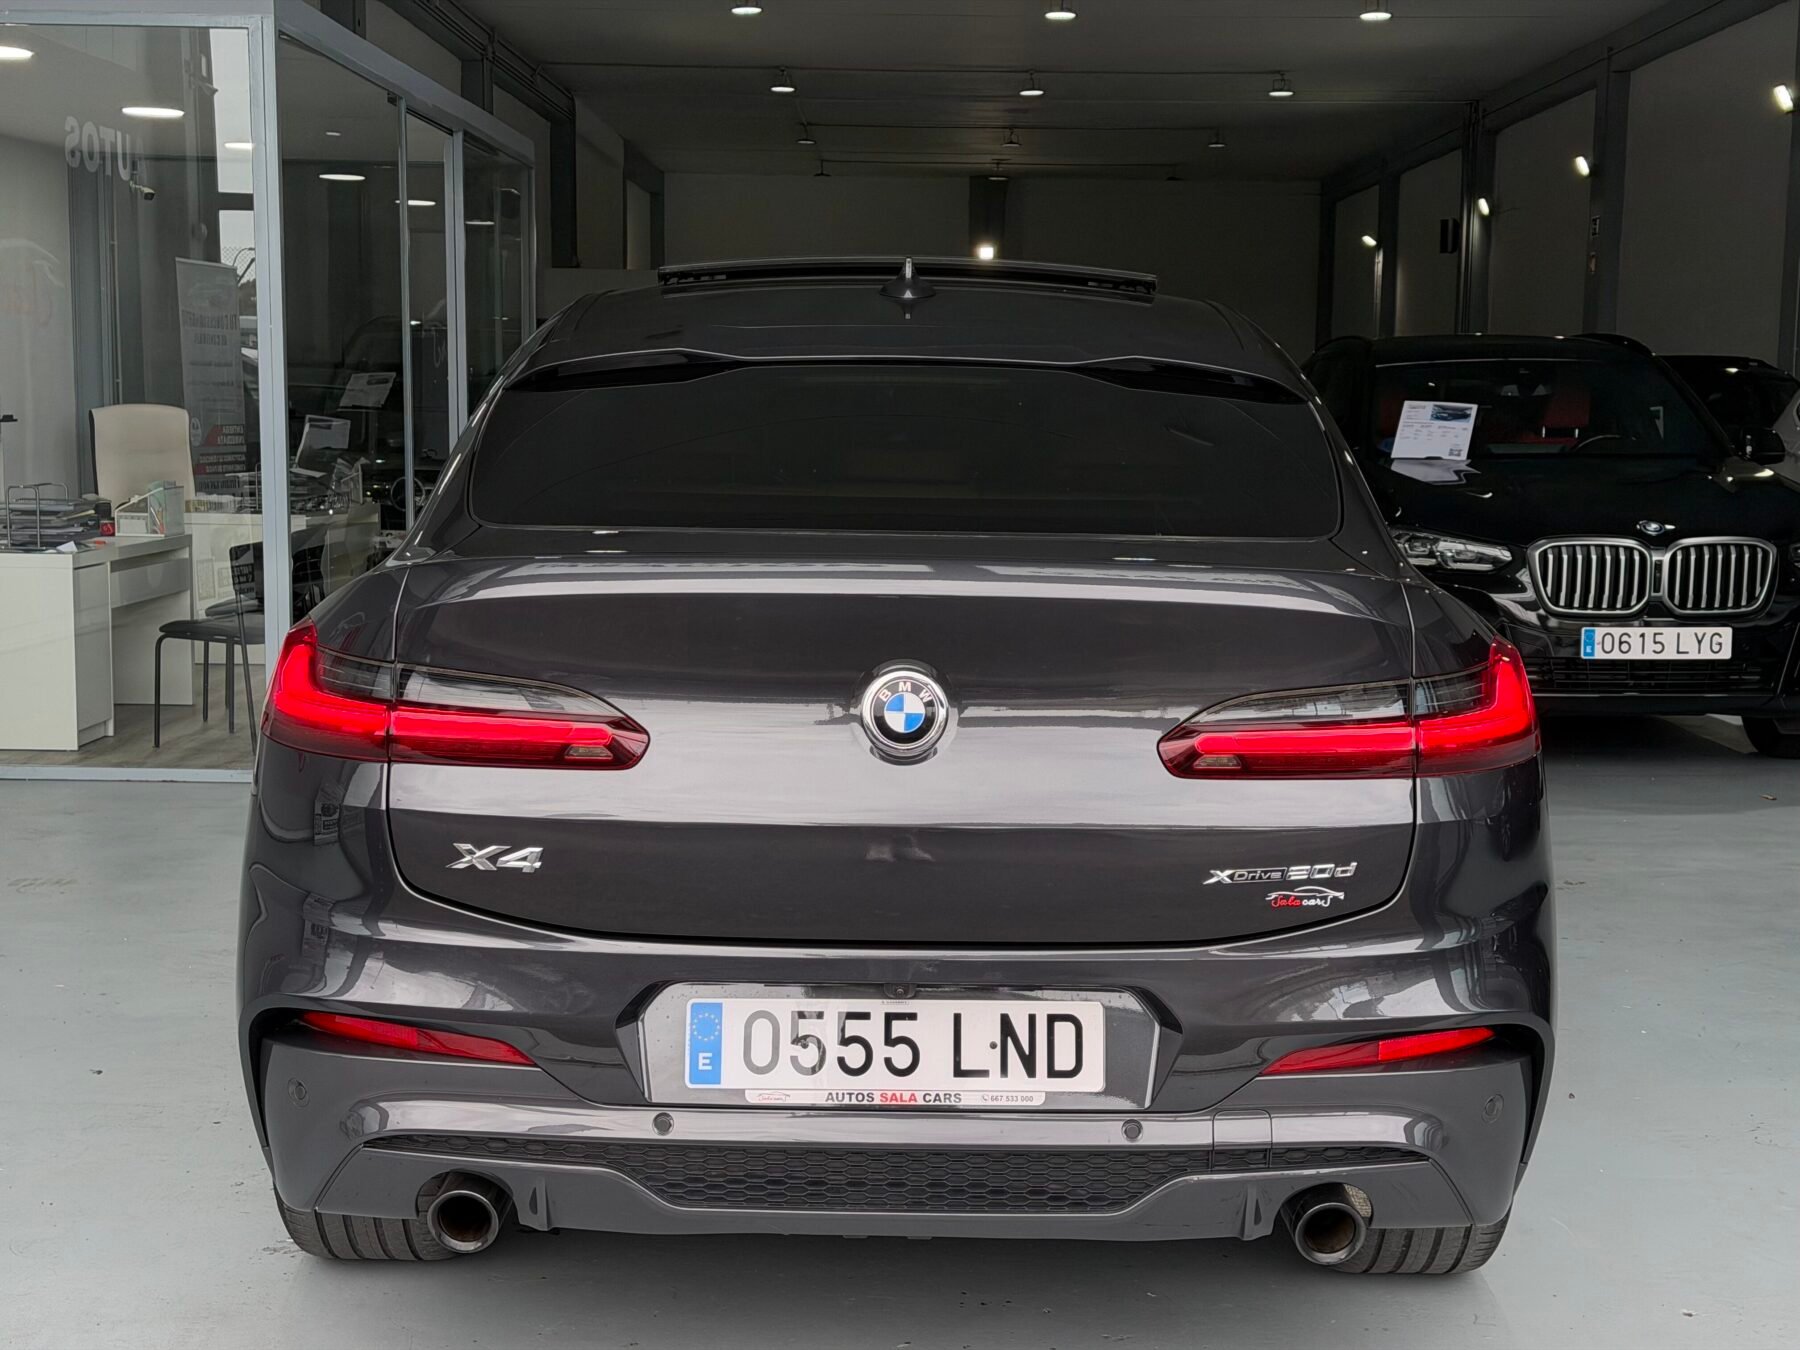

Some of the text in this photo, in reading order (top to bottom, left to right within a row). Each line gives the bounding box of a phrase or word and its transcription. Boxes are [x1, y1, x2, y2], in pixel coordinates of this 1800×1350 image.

[1601, 632, 1723, 655] 0615 LYG
[878, 681, 934, 703] BMW
[445, 843, 544, 873] X4
[743, 1009, 1083, 1079] 0555 LND
[697, 1052, 713, 1071] E
[825, 1092, 1034, 1103] AUTOS SALA CARS 667 533 000
